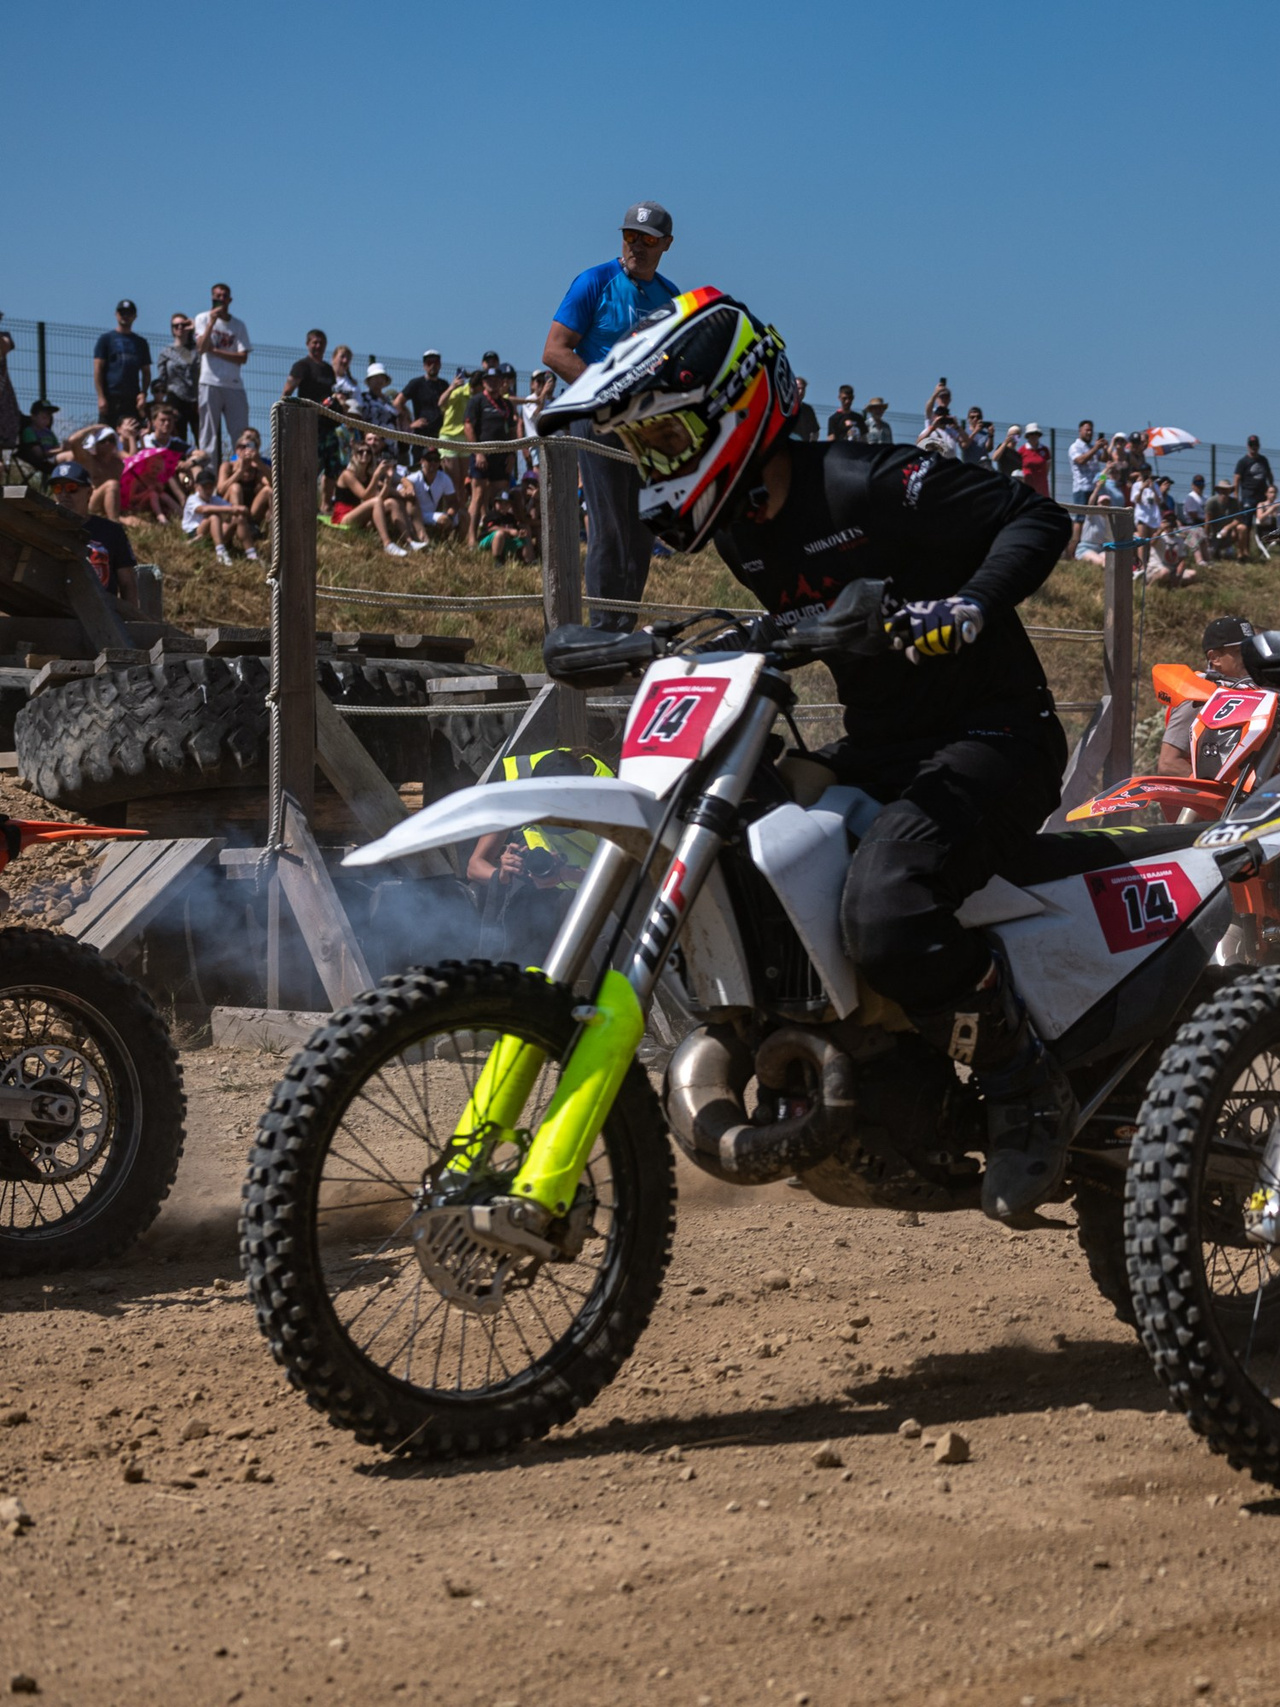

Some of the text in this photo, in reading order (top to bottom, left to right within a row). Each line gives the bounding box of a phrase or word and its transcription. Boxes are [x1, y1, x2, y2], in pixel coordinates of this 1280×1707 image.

[637, 695, 702, 743] 14
[1212, 698, 1244, 721] 5
[1121, 879, 1179, 933] 14
